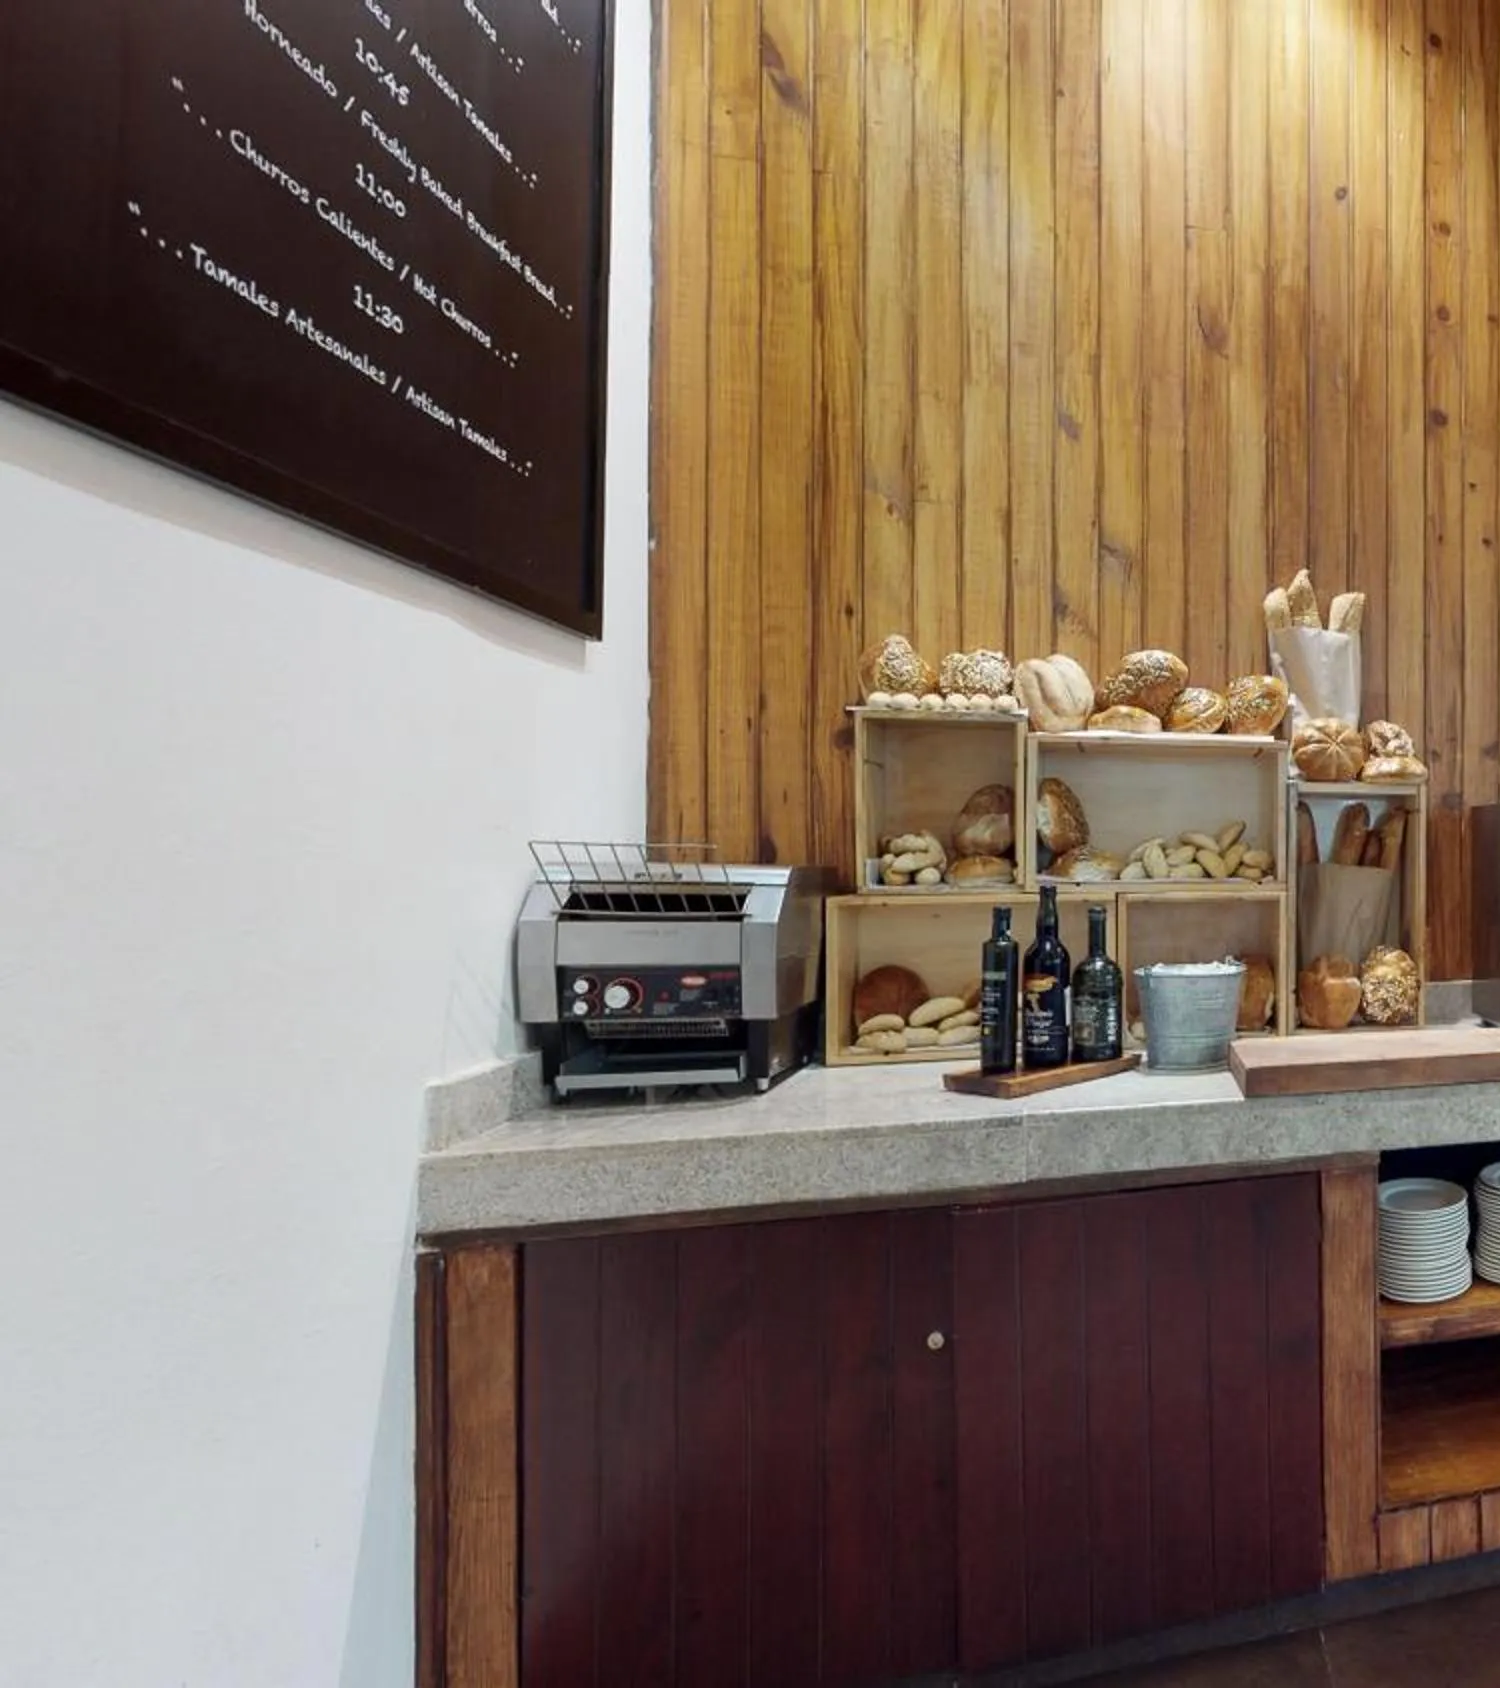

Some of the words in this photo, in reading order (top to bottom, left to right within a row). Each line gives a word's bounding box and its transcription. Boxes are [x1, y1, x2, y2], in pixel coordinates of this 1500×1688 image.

[355, 37, 410, 106] 10:45
[409, 42, 461, 108] Artisan
[463, 98, 513, 163] Tamales
[354, 163, 407, 218] 11:00
[360, 109, 417, 183] Freshly
[420, 165, 464, 220] Baked
[466, 210, 522, 274] Breakfast
[523, 264, 557, 308] Bread
[315, 196, 395, 272] Calientes
[412, 273, 437, 307] Hot
[440, 298, 492, 349] Churros
[354, 284, 404, 334] 11:30
[284, 307, 387, 386] Artesanales
[405, 385, 456, 431] Artisan
[459, 417, 507, 462] Tamales
